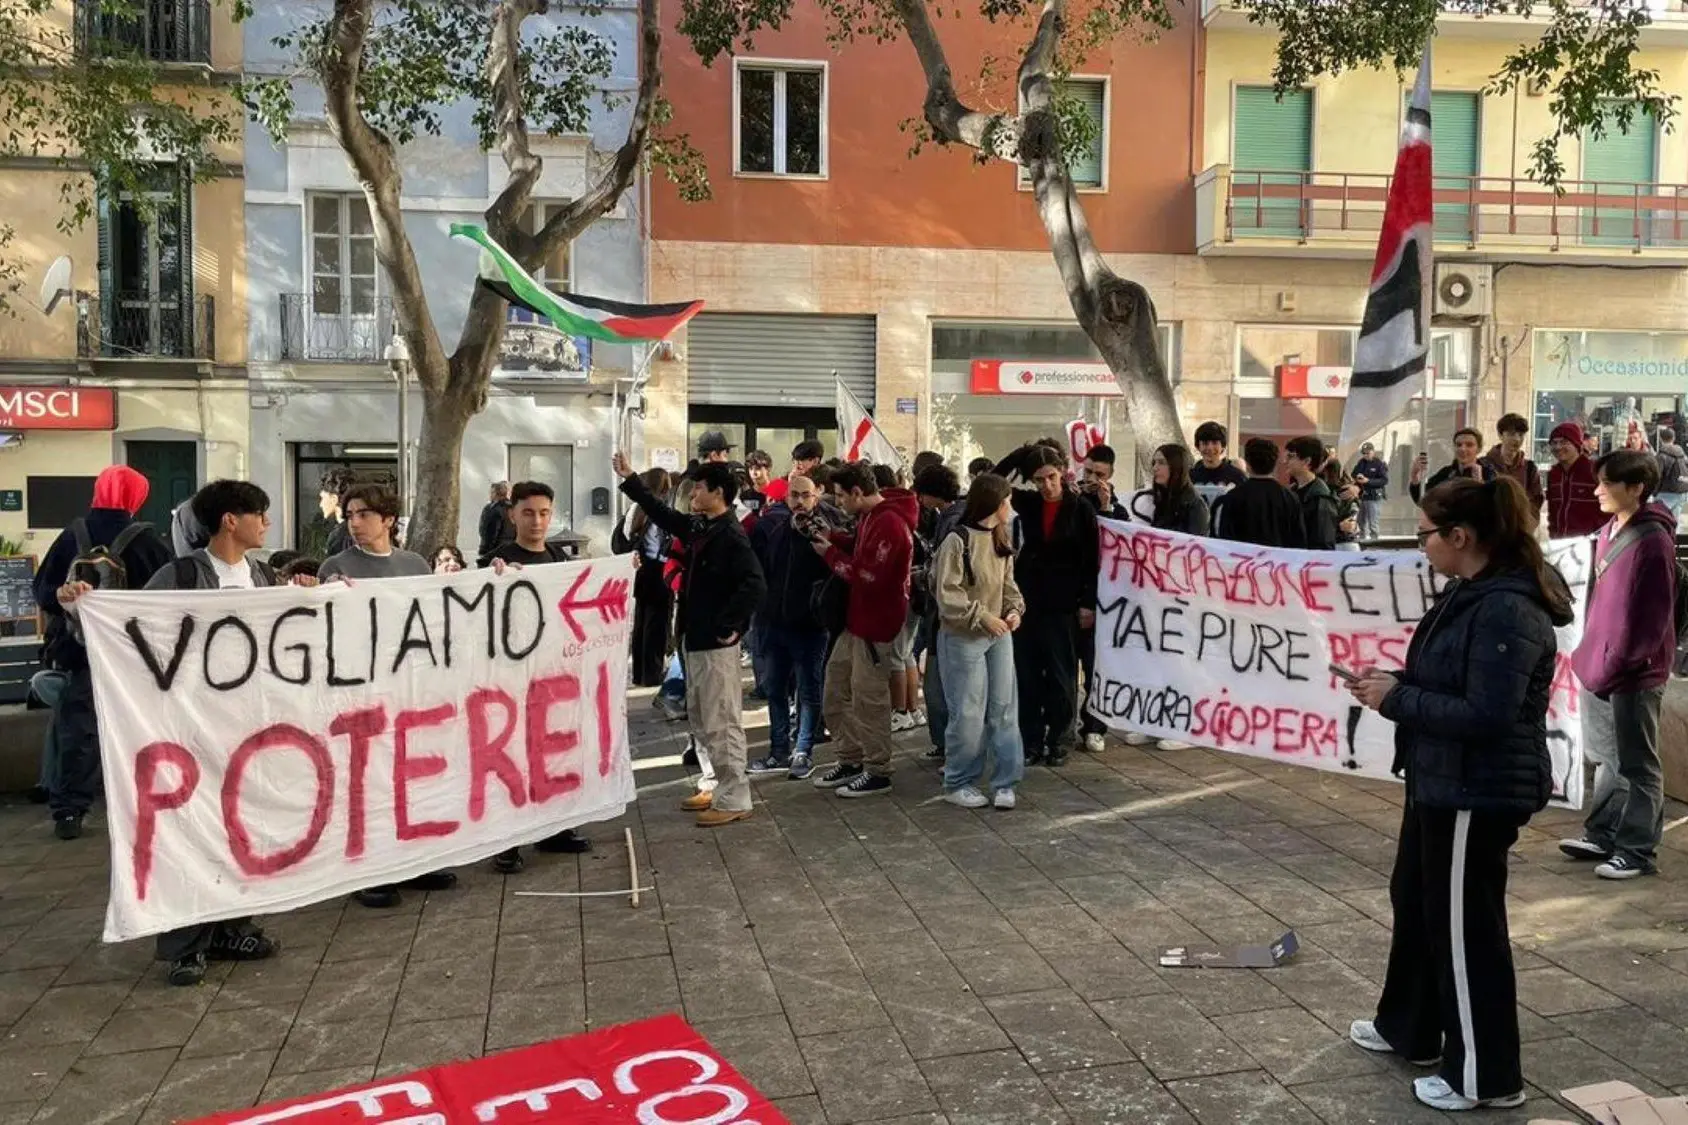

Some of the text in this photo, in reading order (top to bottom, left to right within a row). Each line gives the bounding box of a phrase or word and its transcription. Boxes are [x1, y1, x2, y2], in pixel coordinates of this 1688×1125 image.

[126, 578, 546, 692] VOGLIAMO
[1096, 596, 1152, 653] MA
[1197, 610, 1310, 682] PURE
[133, 660, 613, 901] POTERE!
